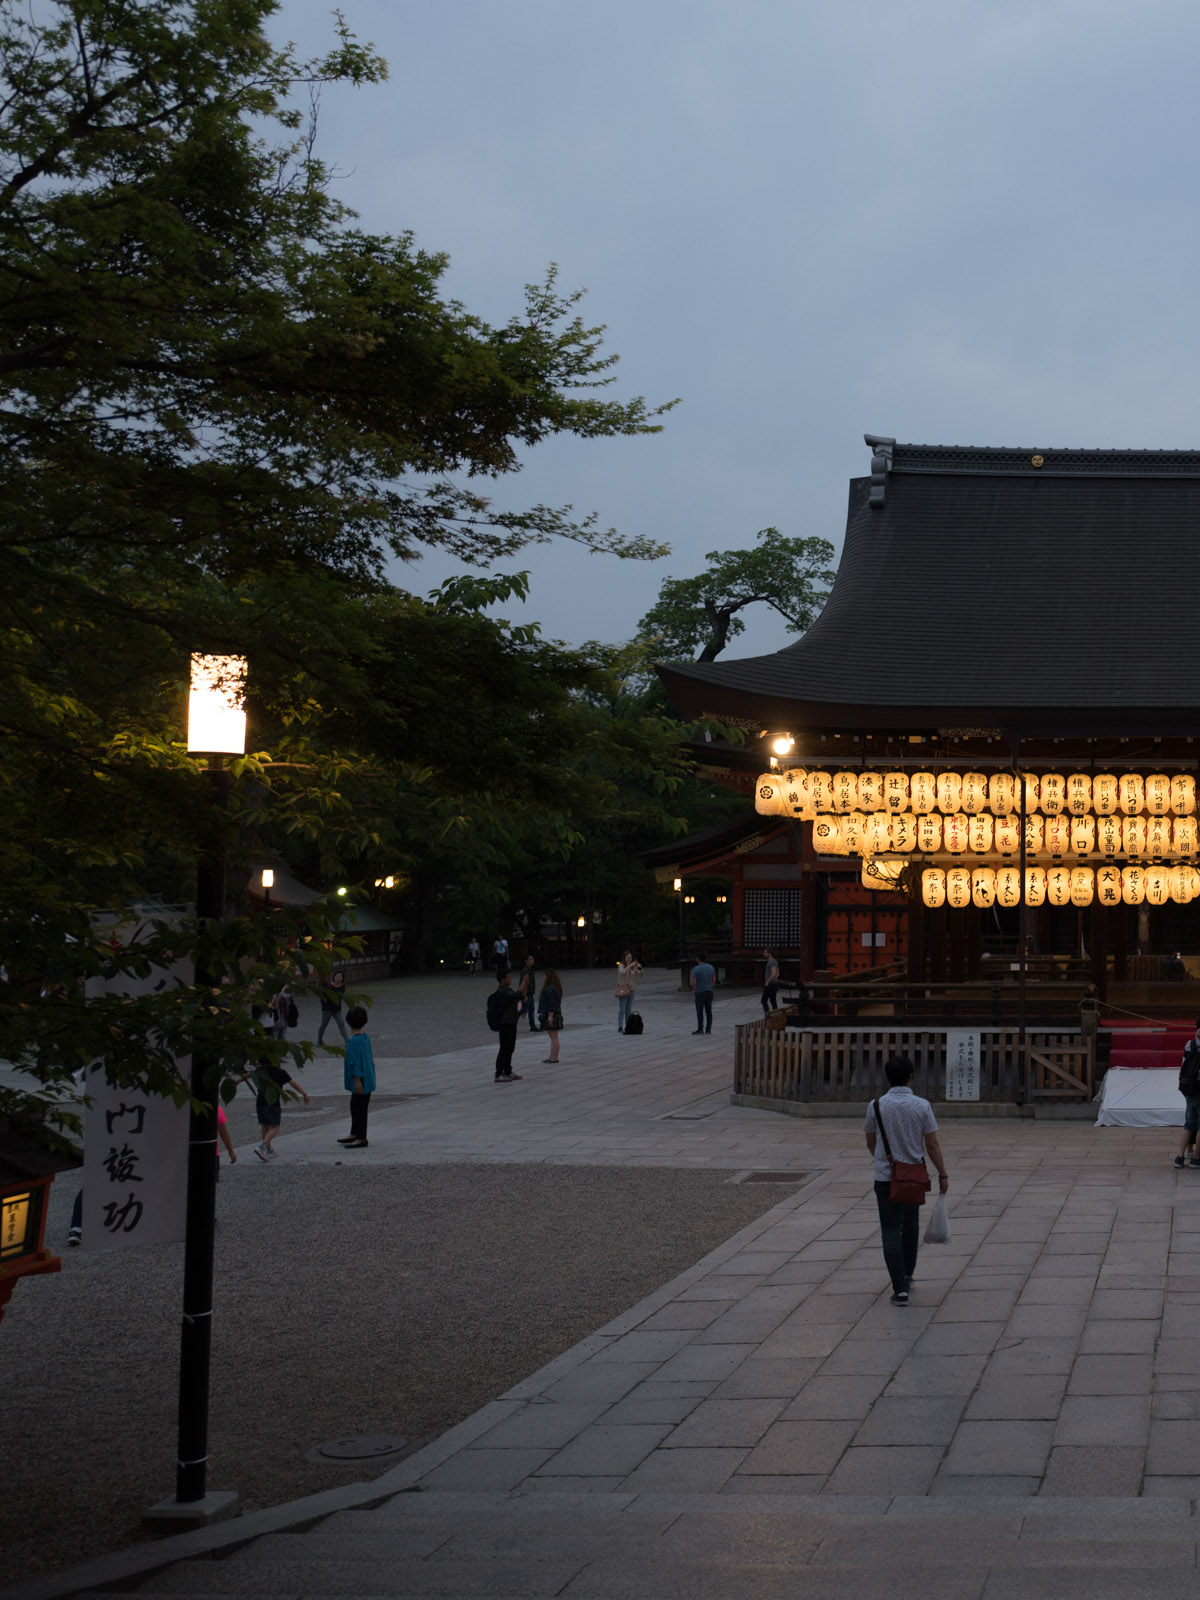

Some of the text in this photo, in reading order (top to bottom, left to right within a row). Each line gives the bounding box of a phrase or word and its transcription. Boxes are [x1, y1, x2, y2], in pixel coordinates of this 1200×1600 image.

[889, 778, 901, 808] 辻留
[1046, 778, 1059, 810] 権兵衛
[1072, 778, 1085, 811] 権兵衛
[897, 817, 907, 847] キメラ
[923, 818, 933, 848] 池田家
[1000, 819, 1011, 847] 豆花
[1076, 819, 1087, 849] 川口
